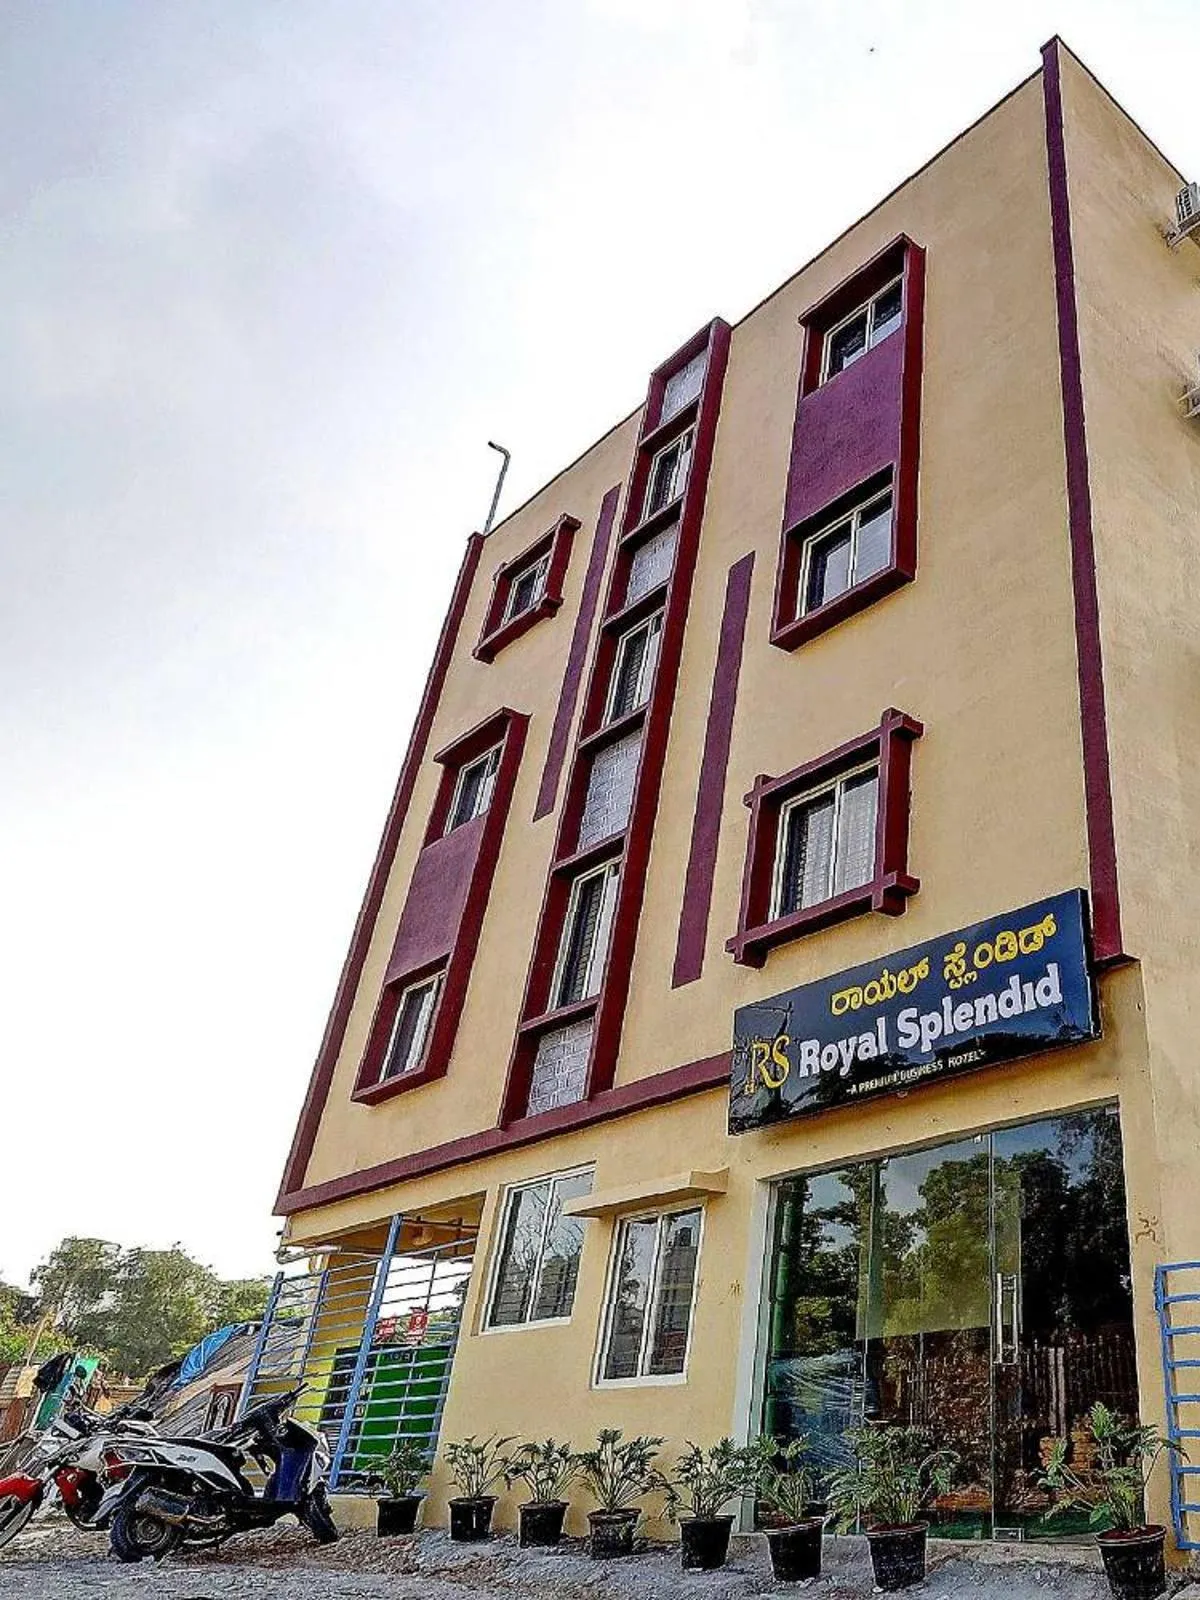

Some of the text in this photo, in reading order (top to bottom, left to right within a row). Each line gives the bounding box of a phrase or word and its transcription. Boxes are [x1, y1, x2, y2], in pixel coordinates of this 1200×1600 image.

[799, 962, 1063, 1078] Royal Splendid
[744, 1034, 790, 1095] RS
